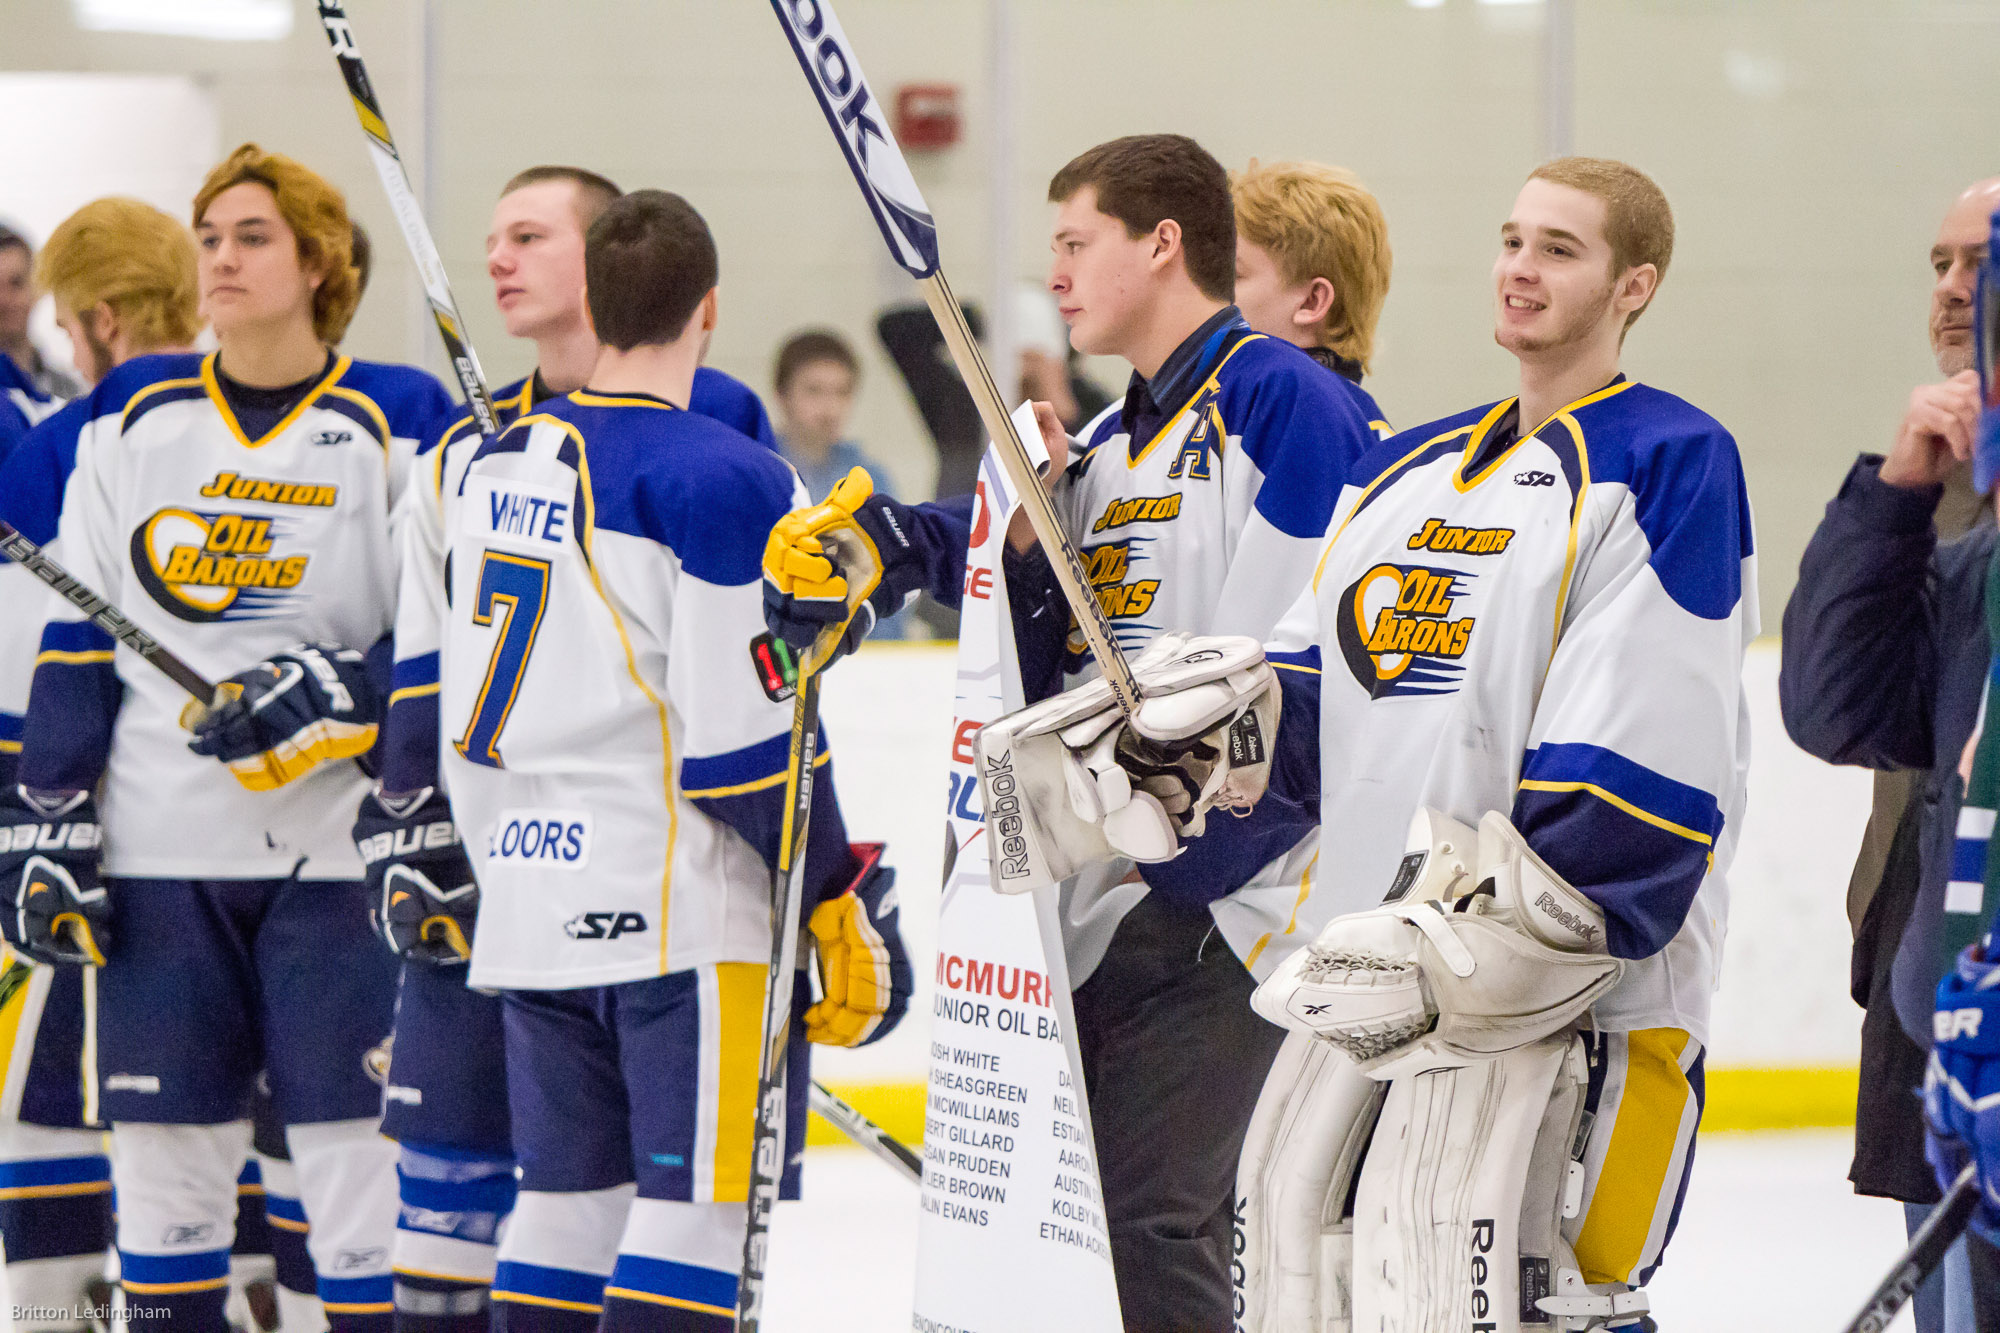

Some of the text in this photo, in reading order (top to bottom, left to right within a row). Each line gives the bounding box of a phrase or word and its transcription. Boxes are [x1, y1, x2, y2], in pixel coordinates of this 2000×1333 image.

[205, 514, 276, 554] OIL
[490, 490, 568, 544] WHITE
[161, 544, 308, 589] BARONS
[1096, 579, 1162, 619] ONS
[1395, 568, 1455, 618] OIL
[1366, 606, 1476, 660] BARONS
[453, 547, 552, 769] 7
[985, 749, 1031, 880] Reebok
[489, 819, 584, 862] OORS
[576, 911, 649, 940] SP
[1534, 891, 1600, 941] Reebok
[997, 1008, 1031, 1037] OIL
[1037, 1015, 1064, 1044] BA
[953, 1047, 1001, 1073] WHITE
[934, 1068, 1028, 1104] SHEASGREEN
[933, 1094, 1021, 1129] MCWILLIAMS
[949, 1125, 1015, 1153] GILLARD
[948, 1151, 1011, 1178] PRUDEN
[949, 1177, 1006, 1204] BROWN
[943, 1201, 989, 1227] EVANS
[1040, 1221, 1084, 1249] ETHAN
